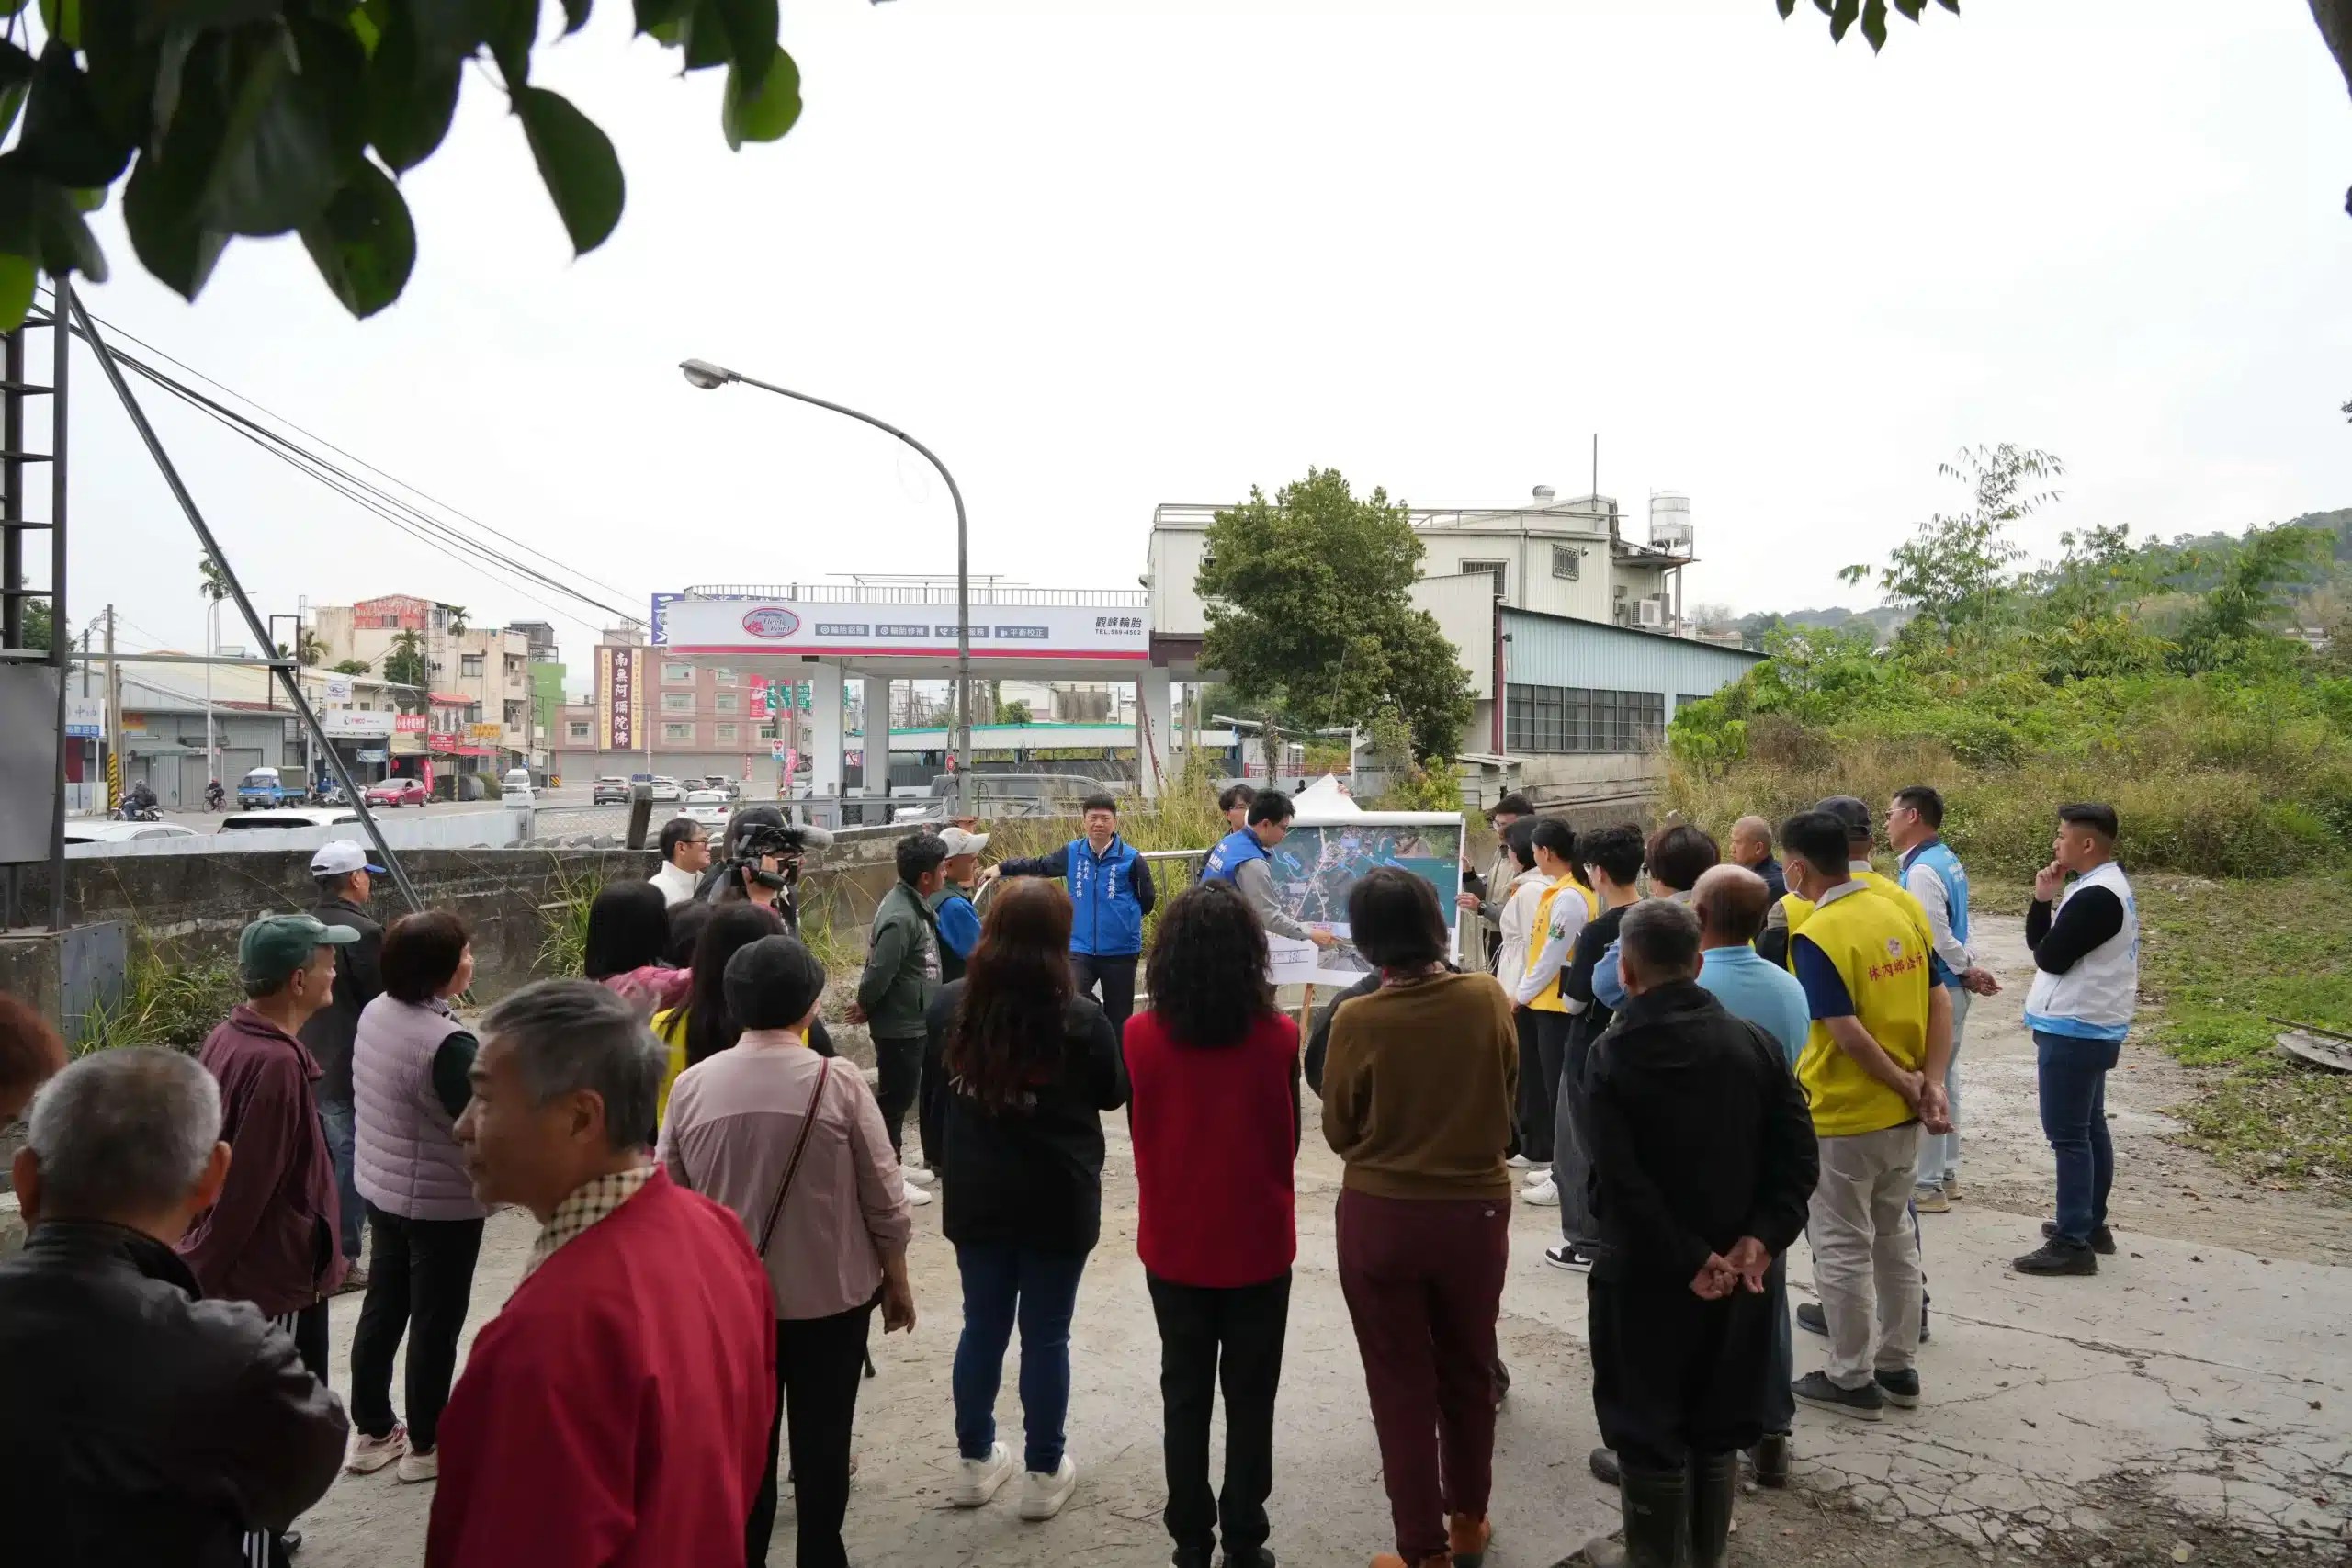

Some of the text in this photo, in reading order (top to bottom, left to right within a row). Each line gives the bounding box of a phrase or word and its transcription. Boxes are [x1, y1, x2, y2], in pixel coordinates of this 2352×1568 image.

[763, 617, 784, 626] Fleet
[1095, 616, 1142, 628] 觀峰輪胎
[890, 626, 924, 636] 輪胎修補
[951, 627, 986, 637] 全服務
[1010, 628, 1045, 637] 平衡校正
[614, 651, 628, 747] 南無阿彌陀佛
[1106, 863, 1117, 900] 雲林縣政府
